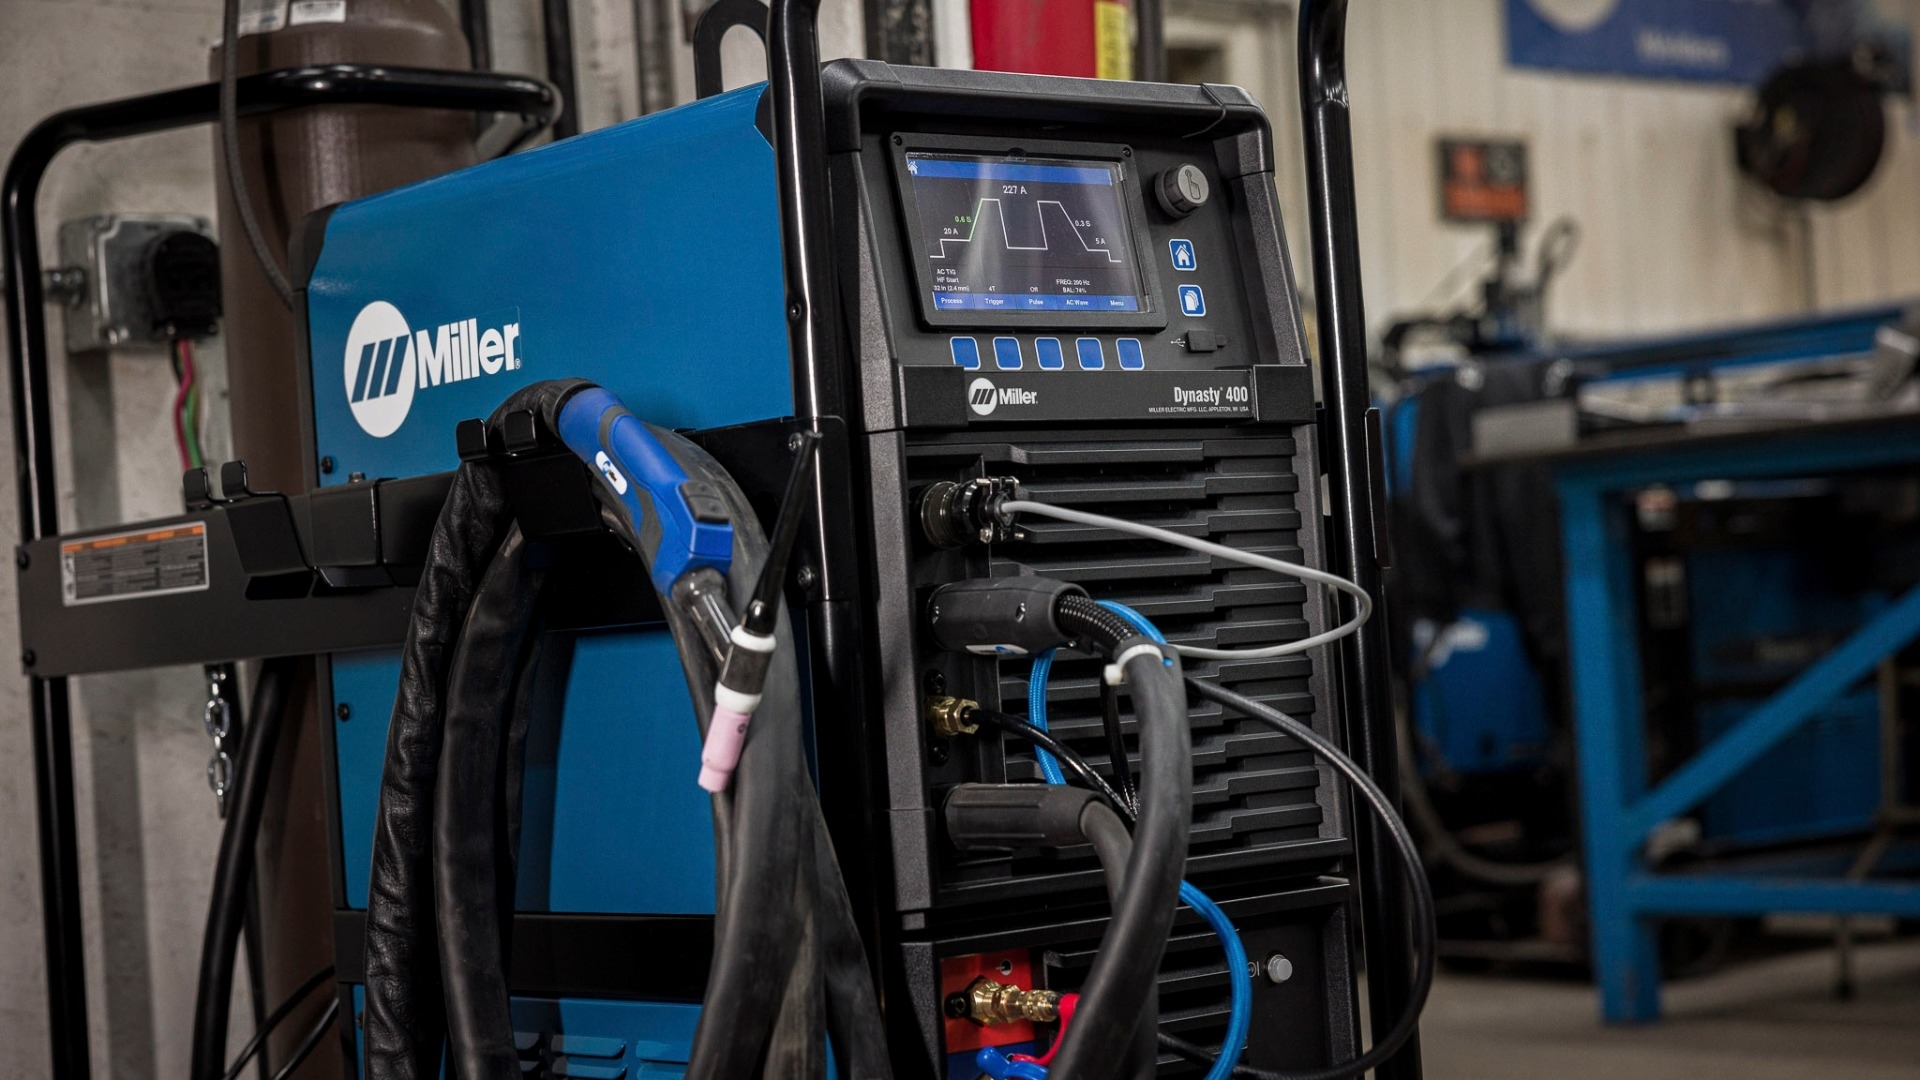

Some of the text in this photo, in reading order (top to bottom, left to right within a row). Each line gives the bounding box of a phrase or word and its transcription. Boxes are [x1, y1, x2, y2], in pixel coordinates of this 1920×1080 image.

[1002, 185, 1027, 195] 227 A
[1074, 219, 1084, 227] 0.3
[943, 227, 951, 235] 20
[1225, 386, 1248, 402] 400
